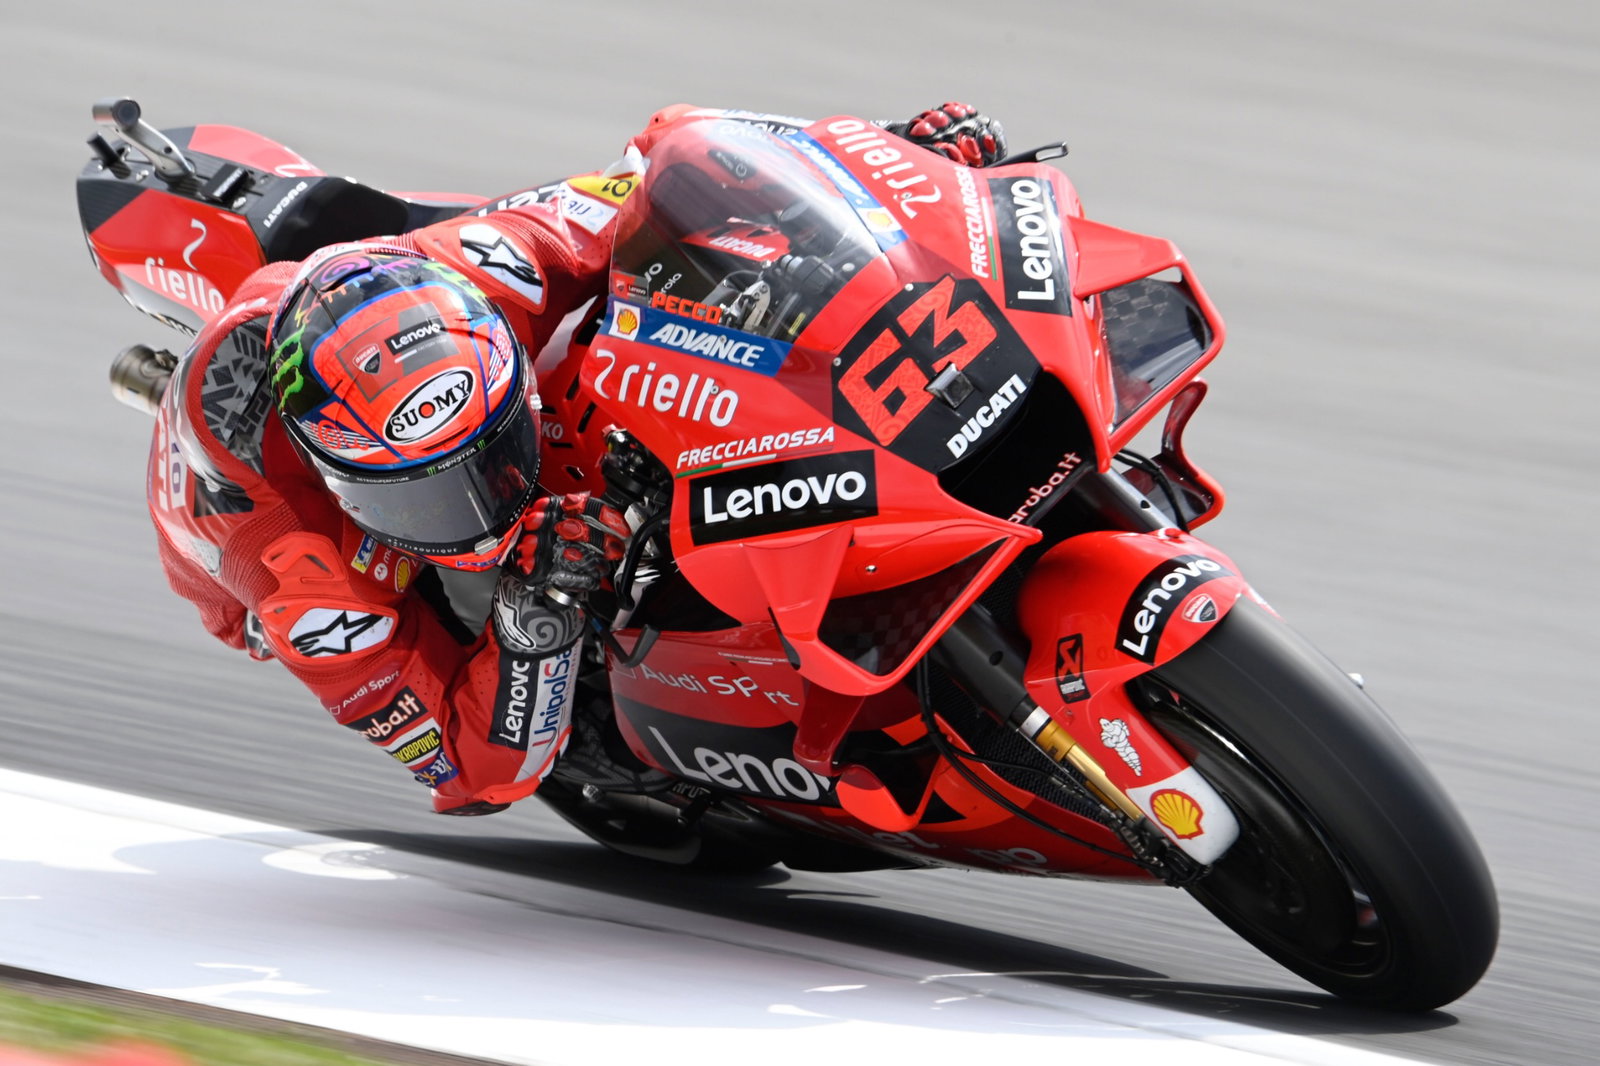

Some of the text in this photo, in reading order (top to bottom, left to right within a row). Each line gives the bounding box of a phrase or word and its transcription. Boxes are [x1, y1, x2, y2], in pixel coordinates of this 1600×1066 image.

[827, 119, 928, 190] riello
[263, 181, 308, 228] DUCATI
[708, 236, 776, 258] DUCATI
[1011, 179, 1055, 301] Lenovo
[145, 257, 225, 315] riello
[651, 291, 722, 325] PECCO
[390, 323, 441, 350] Lenovo
[650, 323, 765, 367] ADVANCE
[837, 274, 998, 447] 63
[390, 379, 470, 434] SUOMY
[618, 361, 739, 428] riello
[946, 374, 1028, 458] DUCATI
[676, 426, 835, 469] FRECCIAROSSA
[703, 470, 866, 524] Lenovo
[1122, 558, 1221, 656] Lenovo
[342, 670, 400, 708] Audi Sport
[640, 663, 707, 694] Audi
[648, 726, 831, 801] Leno
